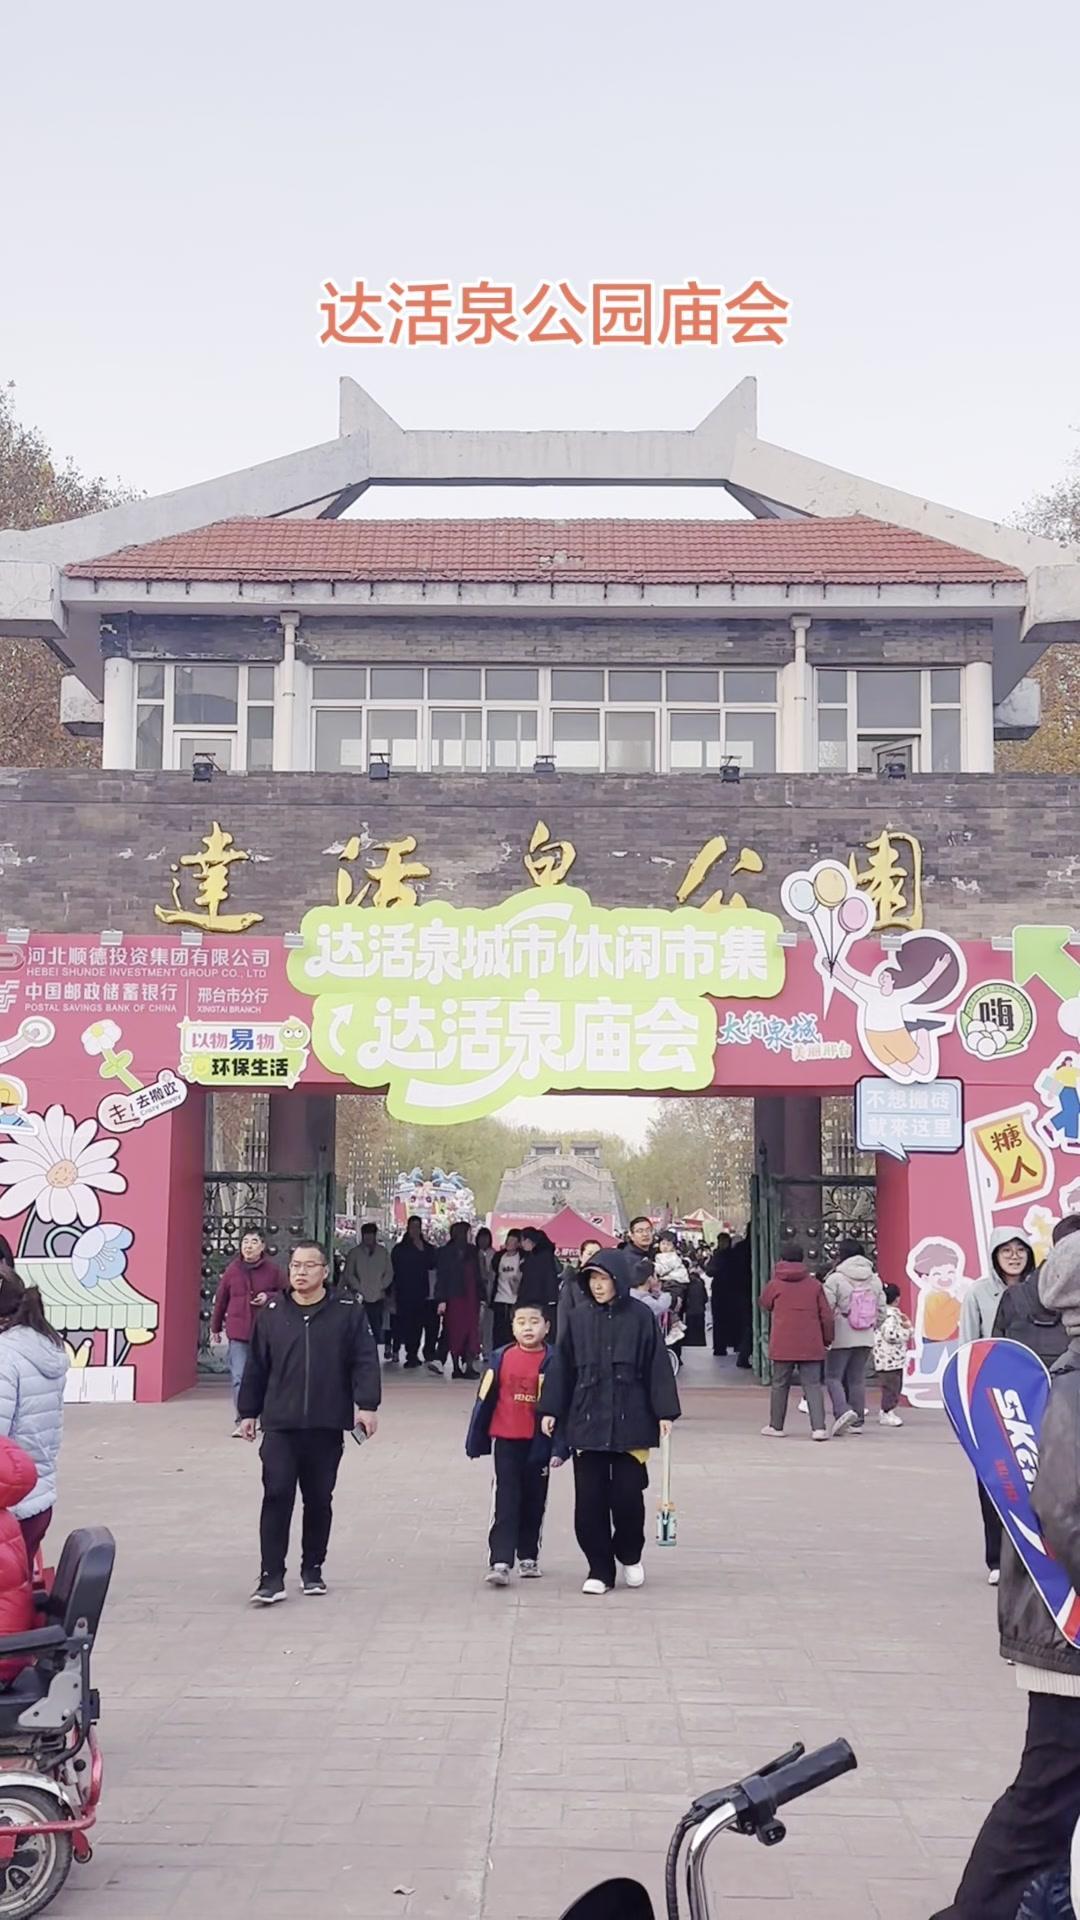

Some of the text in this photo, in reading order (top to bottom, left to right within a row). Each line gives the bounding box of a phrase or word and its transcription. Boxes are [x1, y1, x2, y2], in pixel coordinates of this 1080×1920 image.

[304, 908, 768, 985] 达活泉城市休闲市集
[27, 947, 270, 967] 河北顺德投资集团有限公司
[27, 967, 58, 976] HEBEI
[62, 967, 106, 976] SHUNDE
[110, 968, 176, 977] INVESTMENT
[180, 969, 218, 977] GROUP
[247, 969, 267, 978] LTD
[25, 982, 178, 1001] 中国邮政储蓄银行
[198, 987, 269, 1003] 邢台市分行
[25, 1003, 177, 1012] POSTAL SAVINGS BANK OF CHINA
[197, 1005, 261, 1014] XINGTAI BRANCH
[979, 998, 1014, 1031] 嗨
[191, 1028, 275, 1050] 以物易物
[357, 989, 700, 1086] 达活泉庙会
[718, 1012, 821, 1049] 太行泉城
[211, 1058, 289, 1077] 环保生活
[866, 1089, 950, 1110] 不想搬砖
[867, 1118, 952, 1138] 就来这里
[989, 1123, 1038, 1183] 糖人
